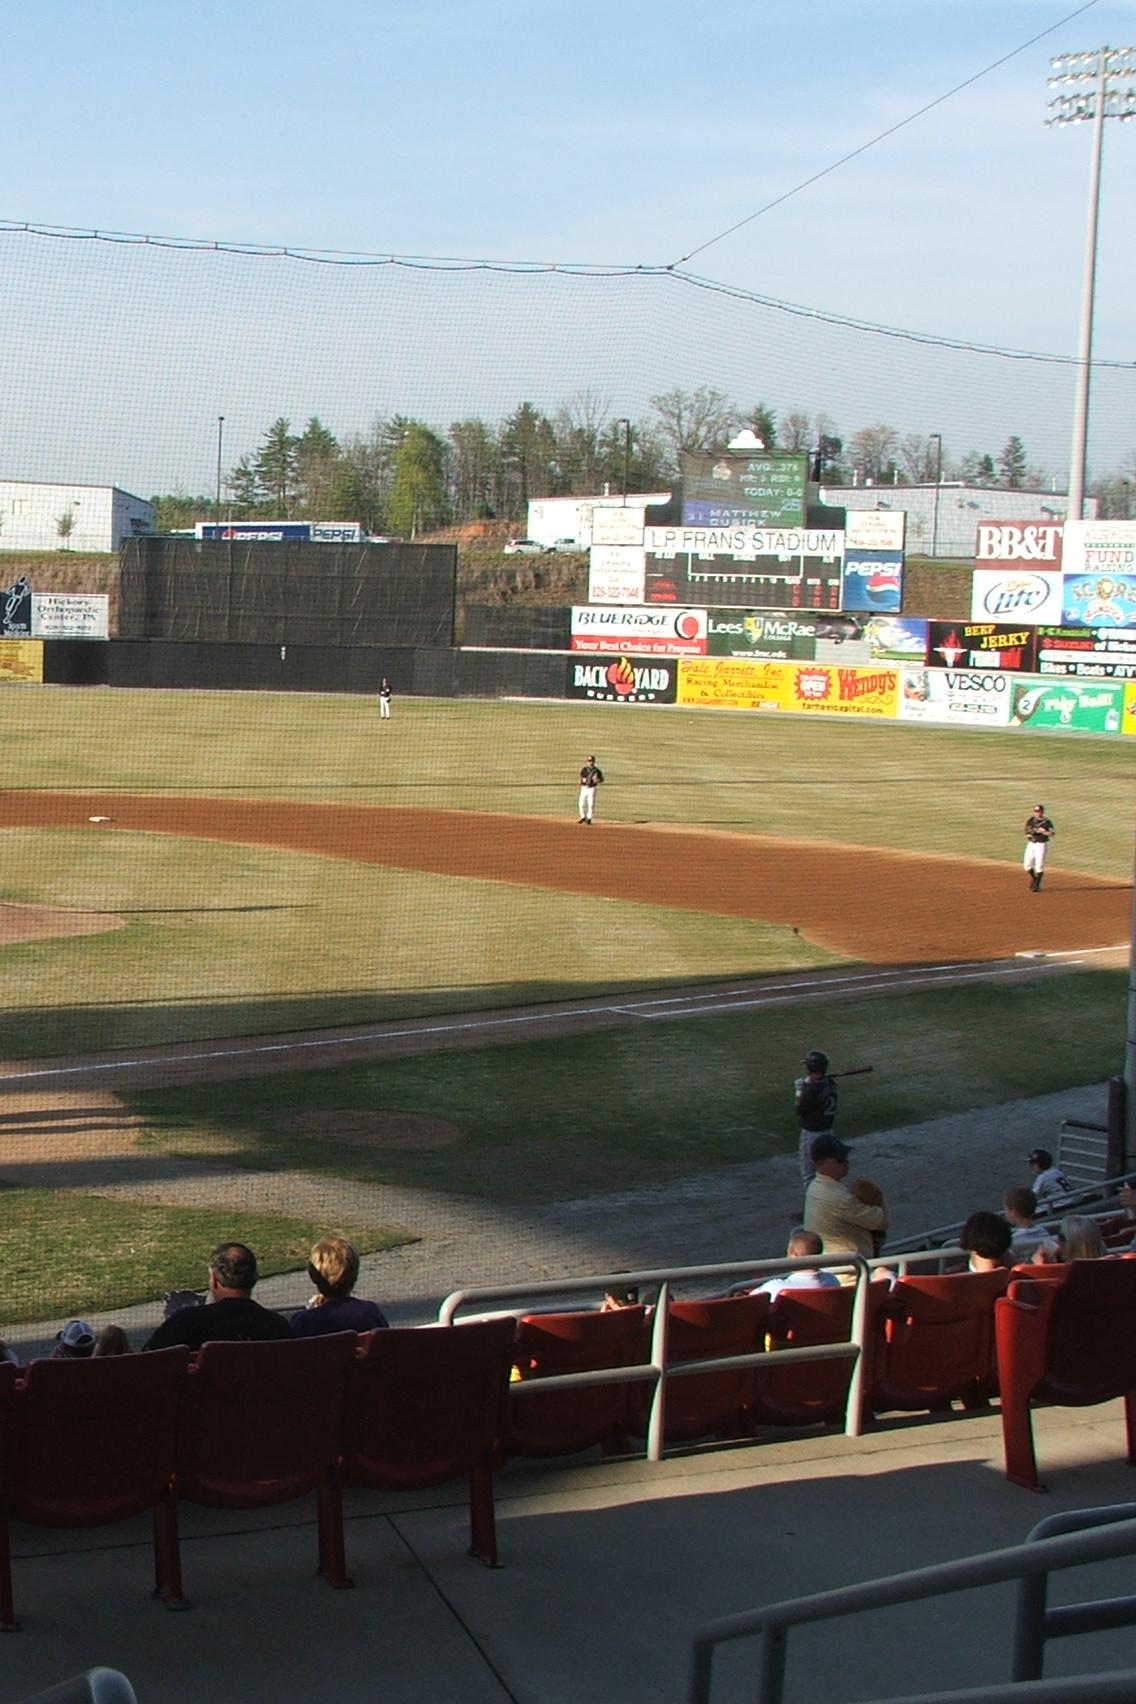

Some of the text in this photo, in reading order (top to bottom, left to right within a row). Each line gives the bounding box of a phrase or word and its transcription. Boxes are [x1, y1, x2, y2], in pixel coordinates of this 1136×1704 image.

[710, 510, 782, 518] MATTHEW
[314, 529, 355, 540] PEPSI
[682, 533, 836, 551] FRANS STADIUM
[976, 526, 1063, 560] BB&T
[1085, 550, 1134, 563] FUND
[845, 562, 902, 576] PEPSI
[48, 598, 89, 606] Hickory
[708, 619, 816, 637] Lees McRae
[965, 625, 996, 637] BEEF
[980, 632, 1030, 648] JERKY
[1094, 642, 1107, 651] of
[576, 640, 701, 656] Your Best Choice for Propane
[1040, 662, 1067, 674] Bikes
[1076, 664, 1105, 676] Boats
[574, 665, 669, 690] BACK YARD
[686, 677, 718, 688] Racing
[945, 672, 1006, 692] VESCO
[723, 690, 776, 700] Collectibles
